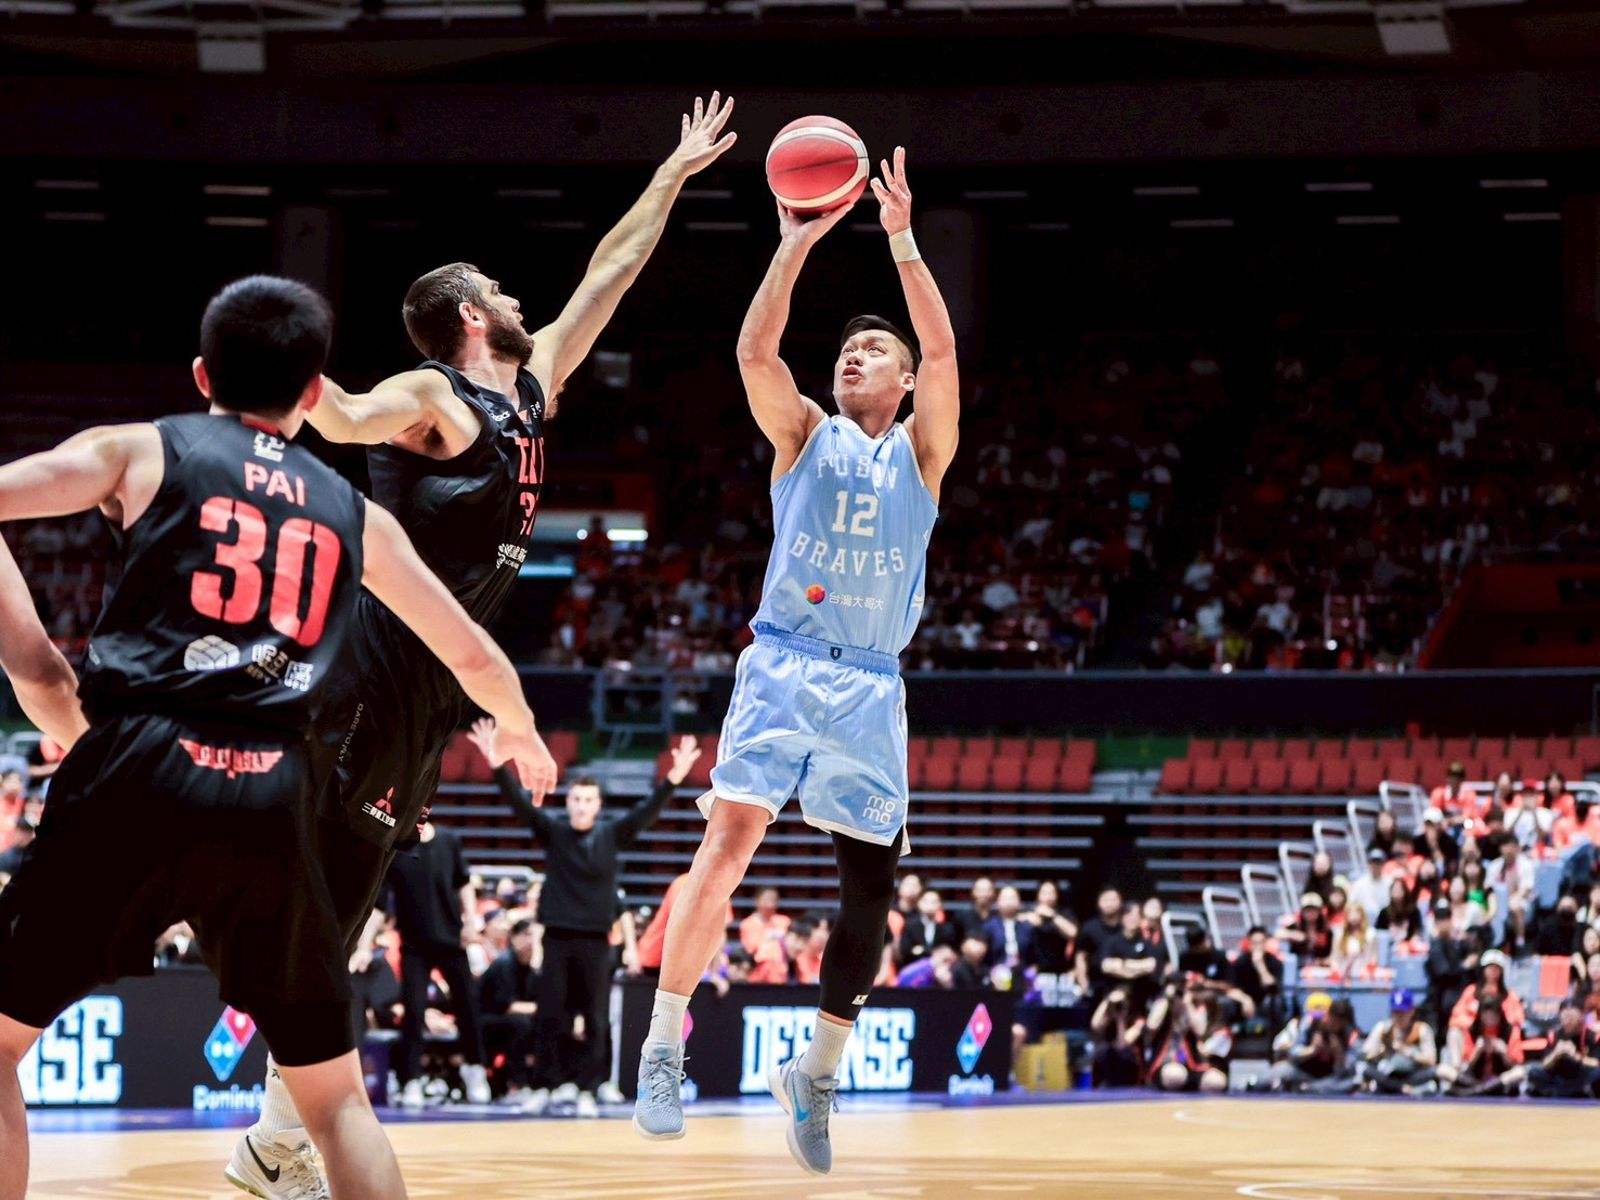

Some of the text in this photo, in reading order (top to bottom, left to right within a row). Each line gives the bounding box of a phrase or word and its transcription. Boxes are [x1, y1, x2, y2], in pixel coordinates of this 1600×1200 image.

[244, 461, 305, 507] PAI
[831, 490, 879, 538] 12
[190, 495, 342, 648] 30
[789, 531, 905, 577] BRAVES
[829, 591, 885, 610] 台灣大哥大
[740, 1006, 915, 1093] DEFNSE
